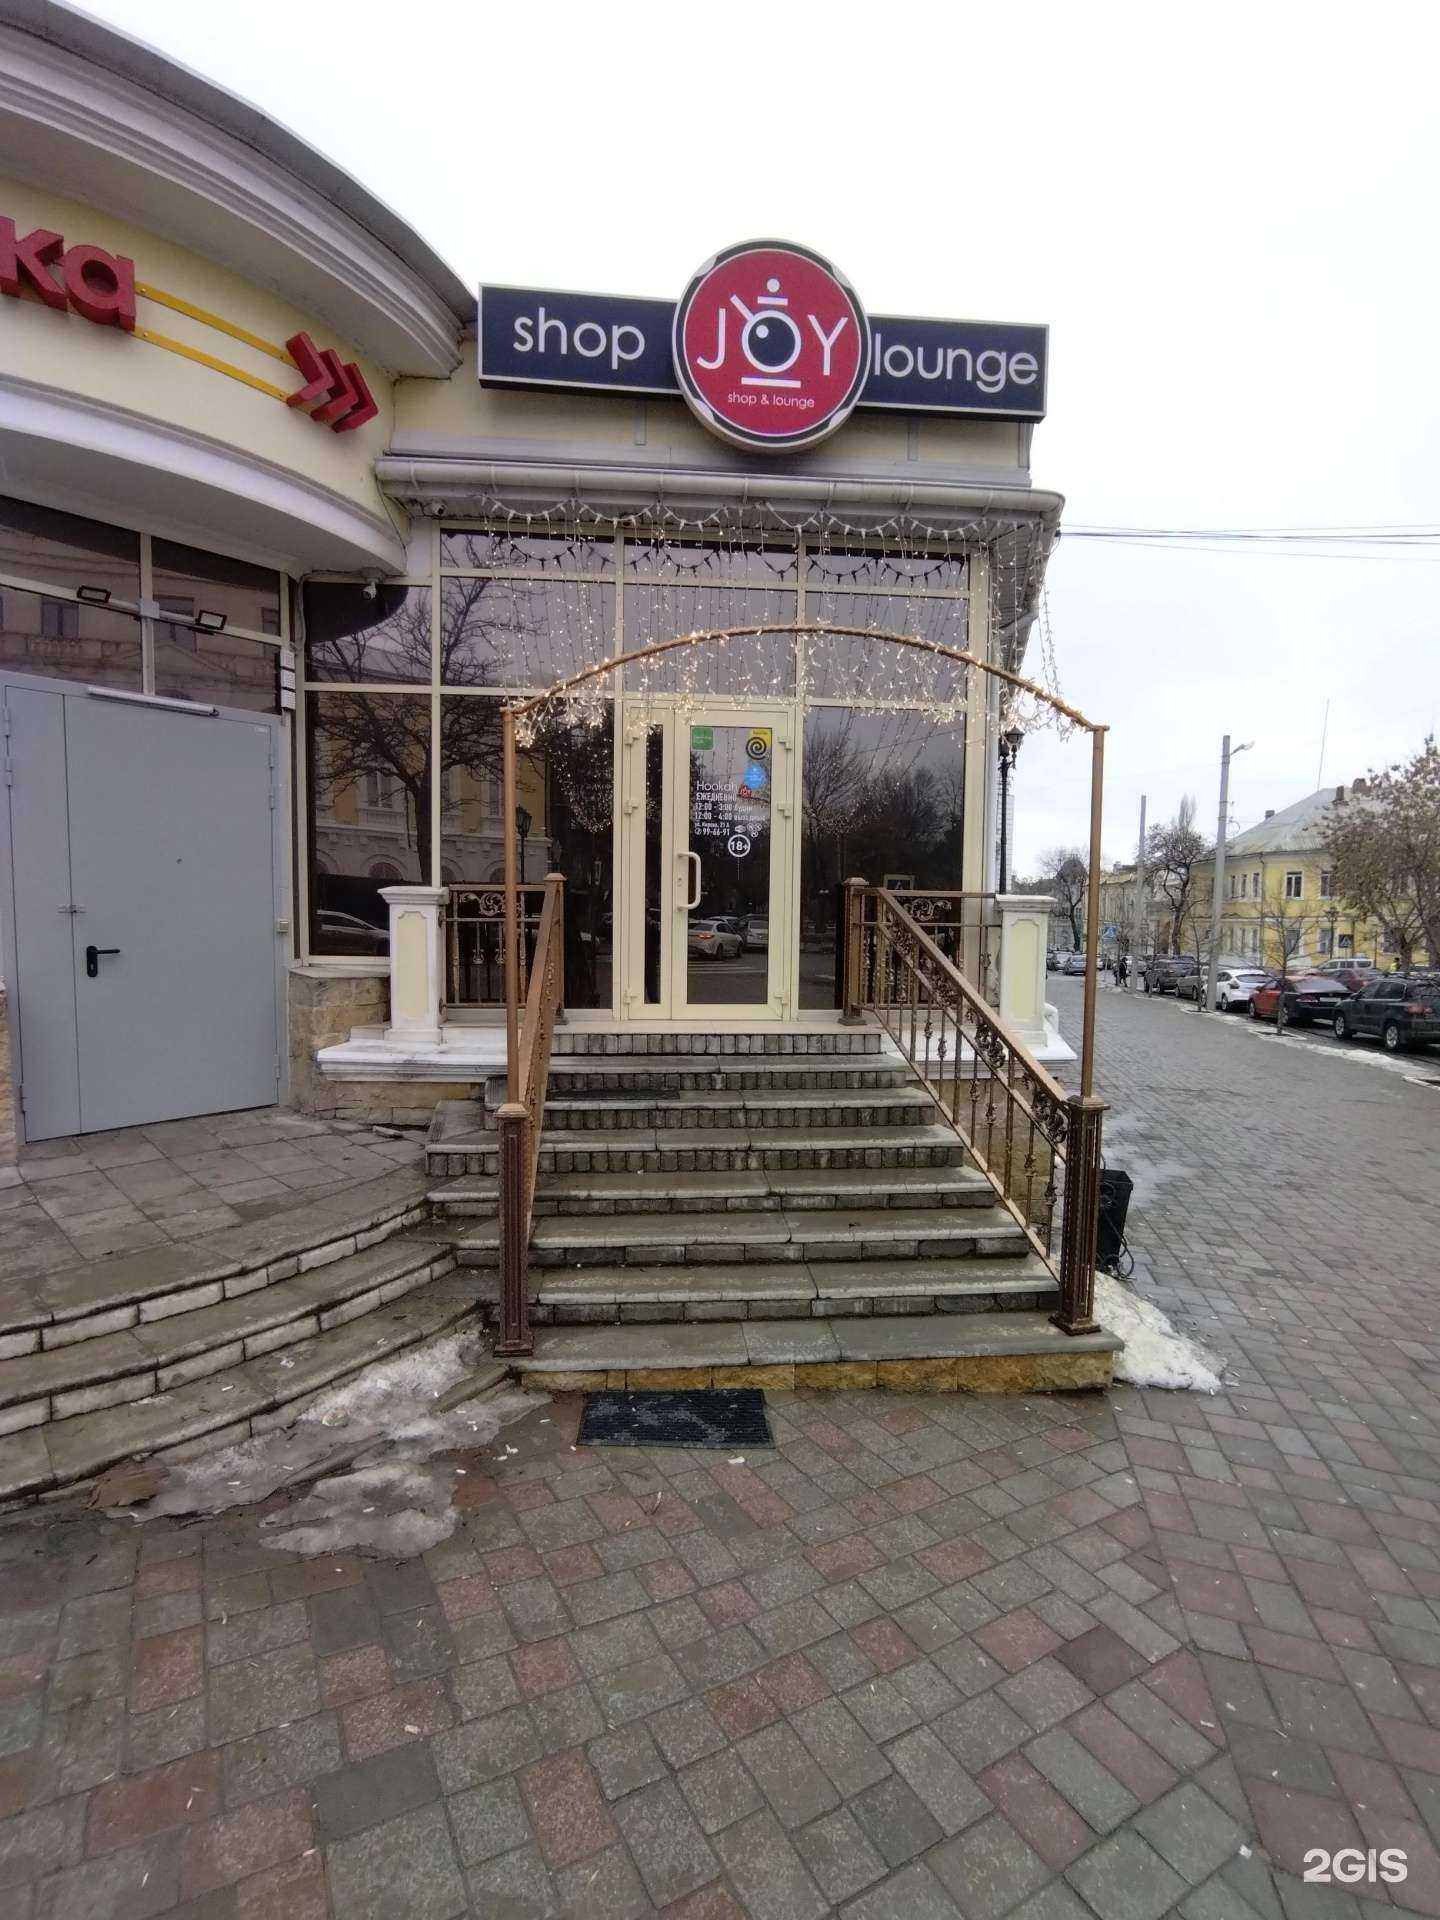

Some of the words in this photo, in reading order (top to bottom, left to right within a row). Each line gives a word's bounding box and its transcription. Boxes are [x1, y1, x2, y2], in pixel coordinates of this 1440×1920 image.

[513, 306, 645, 370] shop
[697, 308, 848, 376] JOY
[874, 333, 1039, 393] lounge
[728, 391, 758, 406] shop
[761, 394, 769, 405] &
[772, 394, 815, 409] lounge
[696, 780, 737, 792] Hookah
[695, 802, 712, 811] 12:00
[718, 803, 732, 811] 3:00
[695, 812, 712, 820] 12:00
[718, 812, 733, 821] 4:00
[702, 828, 730, 836] 99-66-91
[730, 841, 748, 851] 18+
